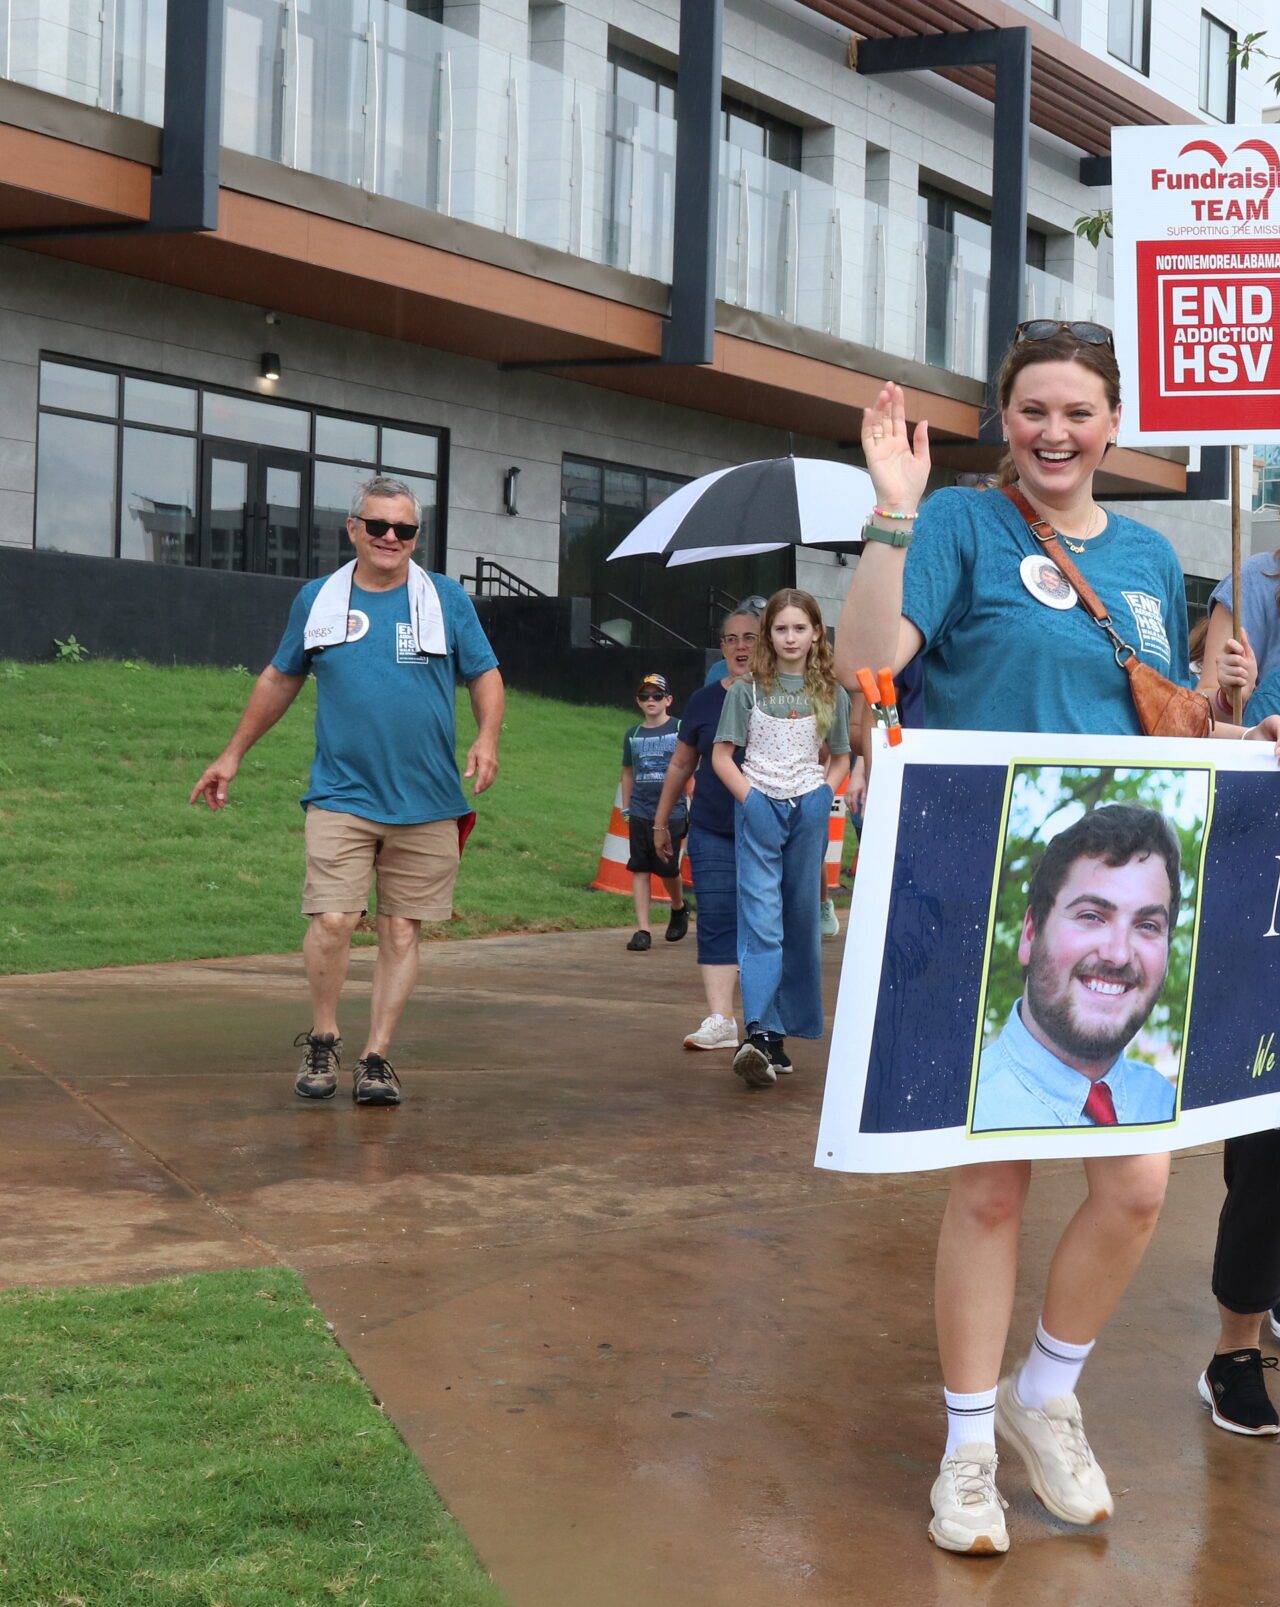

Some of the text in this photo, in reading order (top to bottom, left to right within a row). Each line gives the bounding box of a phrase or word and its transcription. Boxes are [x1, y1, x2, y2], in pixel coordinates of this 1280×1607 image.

[1191, 199, 1269, 221] TEAM
[1167, 226, 1229, 236] SUPPORTING
[1232, 225, 1251, 235] THE
[1171, 285, 1273, 326] END
[1173, 326, 1273, 344] ADDICTION
[1173, 343, 1273, 384] HSV
[399, 639, 416, 649] HS
[1252, 1032, 1275, 1079] We
